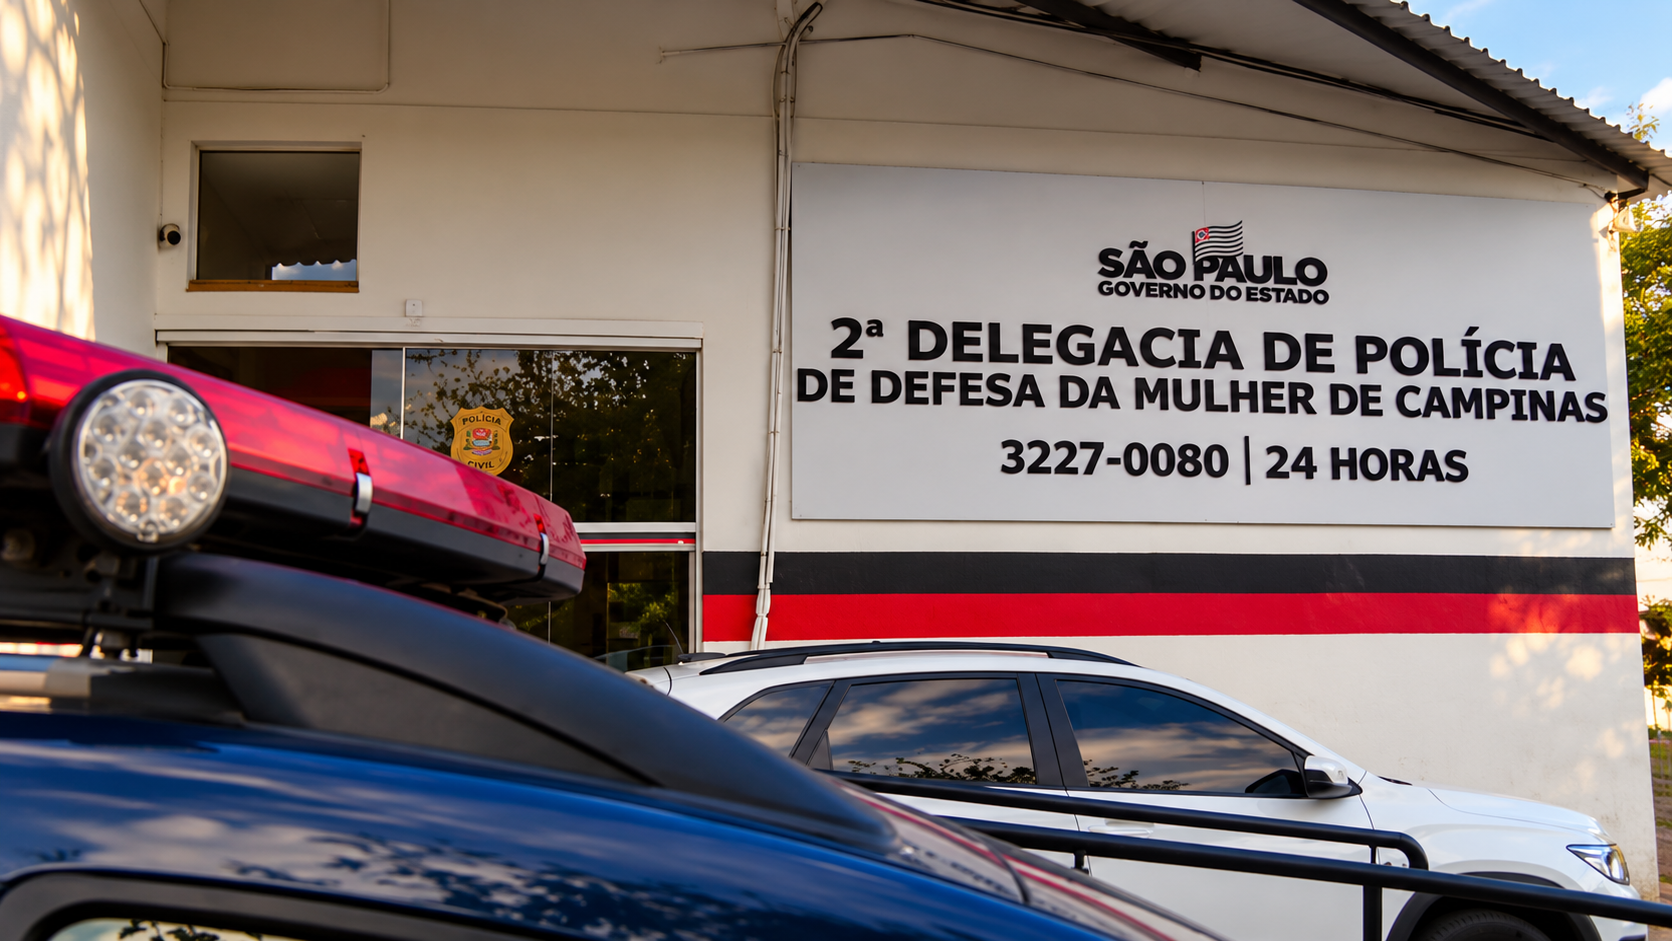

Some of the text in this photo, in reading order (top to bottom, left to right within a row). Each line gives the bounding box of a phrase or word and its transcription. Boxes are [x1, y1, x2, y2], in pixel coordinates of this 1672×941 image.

[1097, 240, 1328, 287] SÃO PAULO
[1097, 280, 1330, 305] GOVERNO DO ESTADO
[830, 317, 1577, 382] 2ª DELEGACIA DE POLÍCIA
[796, 367, 1608, 424] DE DEFESA DA MULHER DE CAMPINAS
[1000, 439, 1469, 483] 3227-0080 24 HORAS
